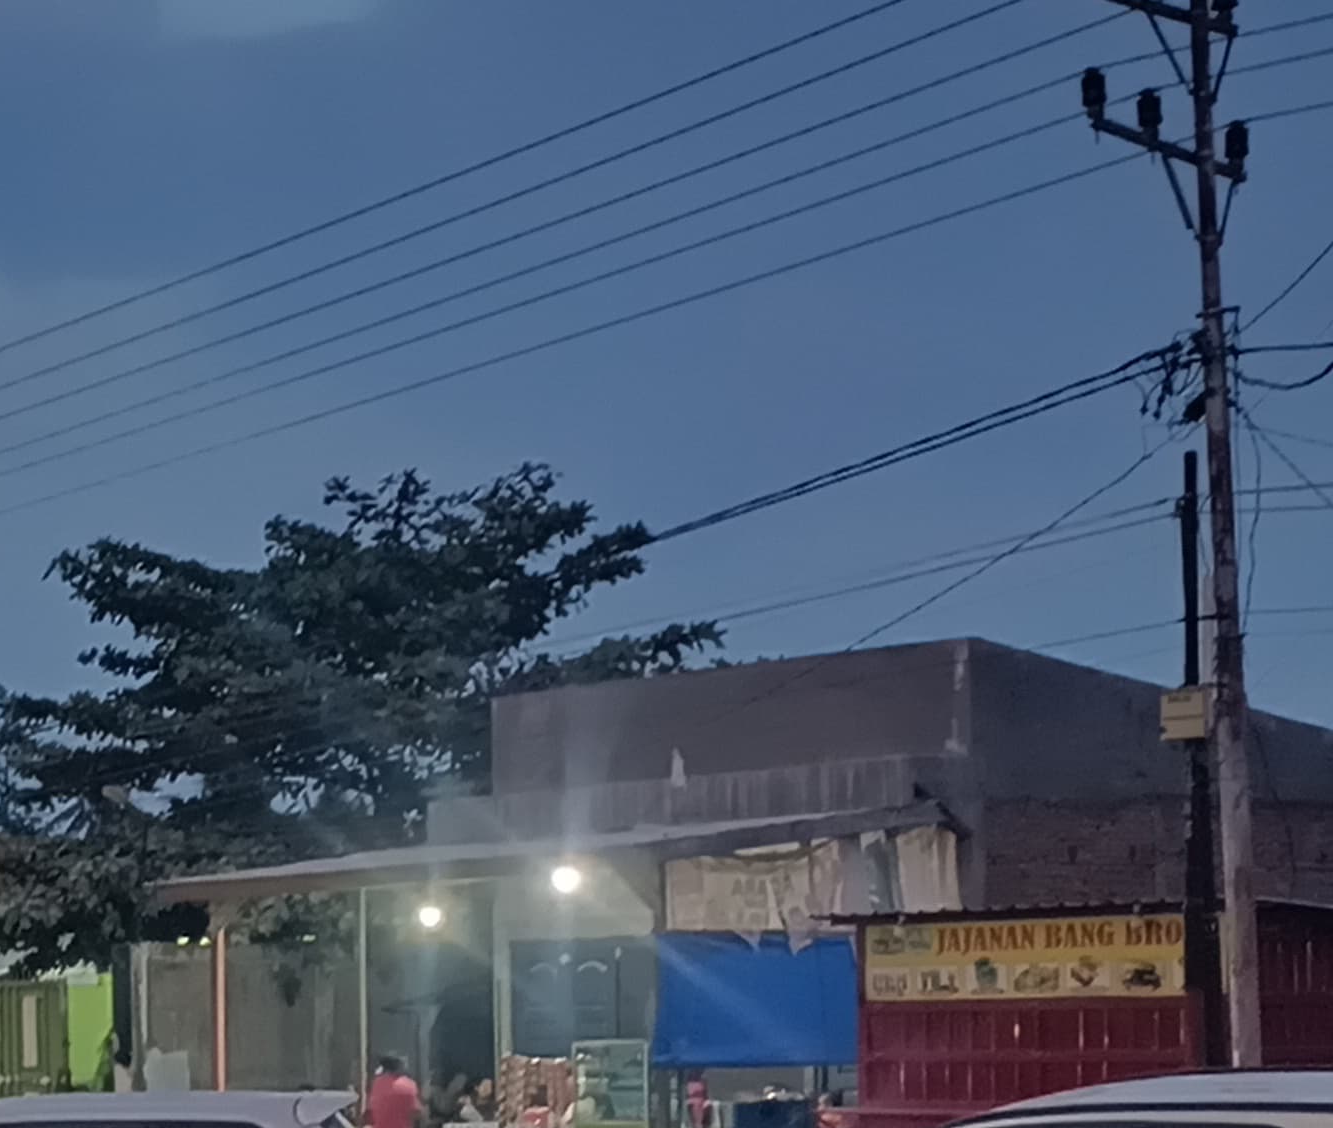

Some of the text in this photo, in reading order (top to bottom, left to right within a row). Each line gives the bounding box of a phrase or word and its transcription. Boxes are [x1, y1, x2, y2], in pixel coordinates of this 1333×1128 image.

[937, 918, 1182, 955] JAJANAN BANG BRO
